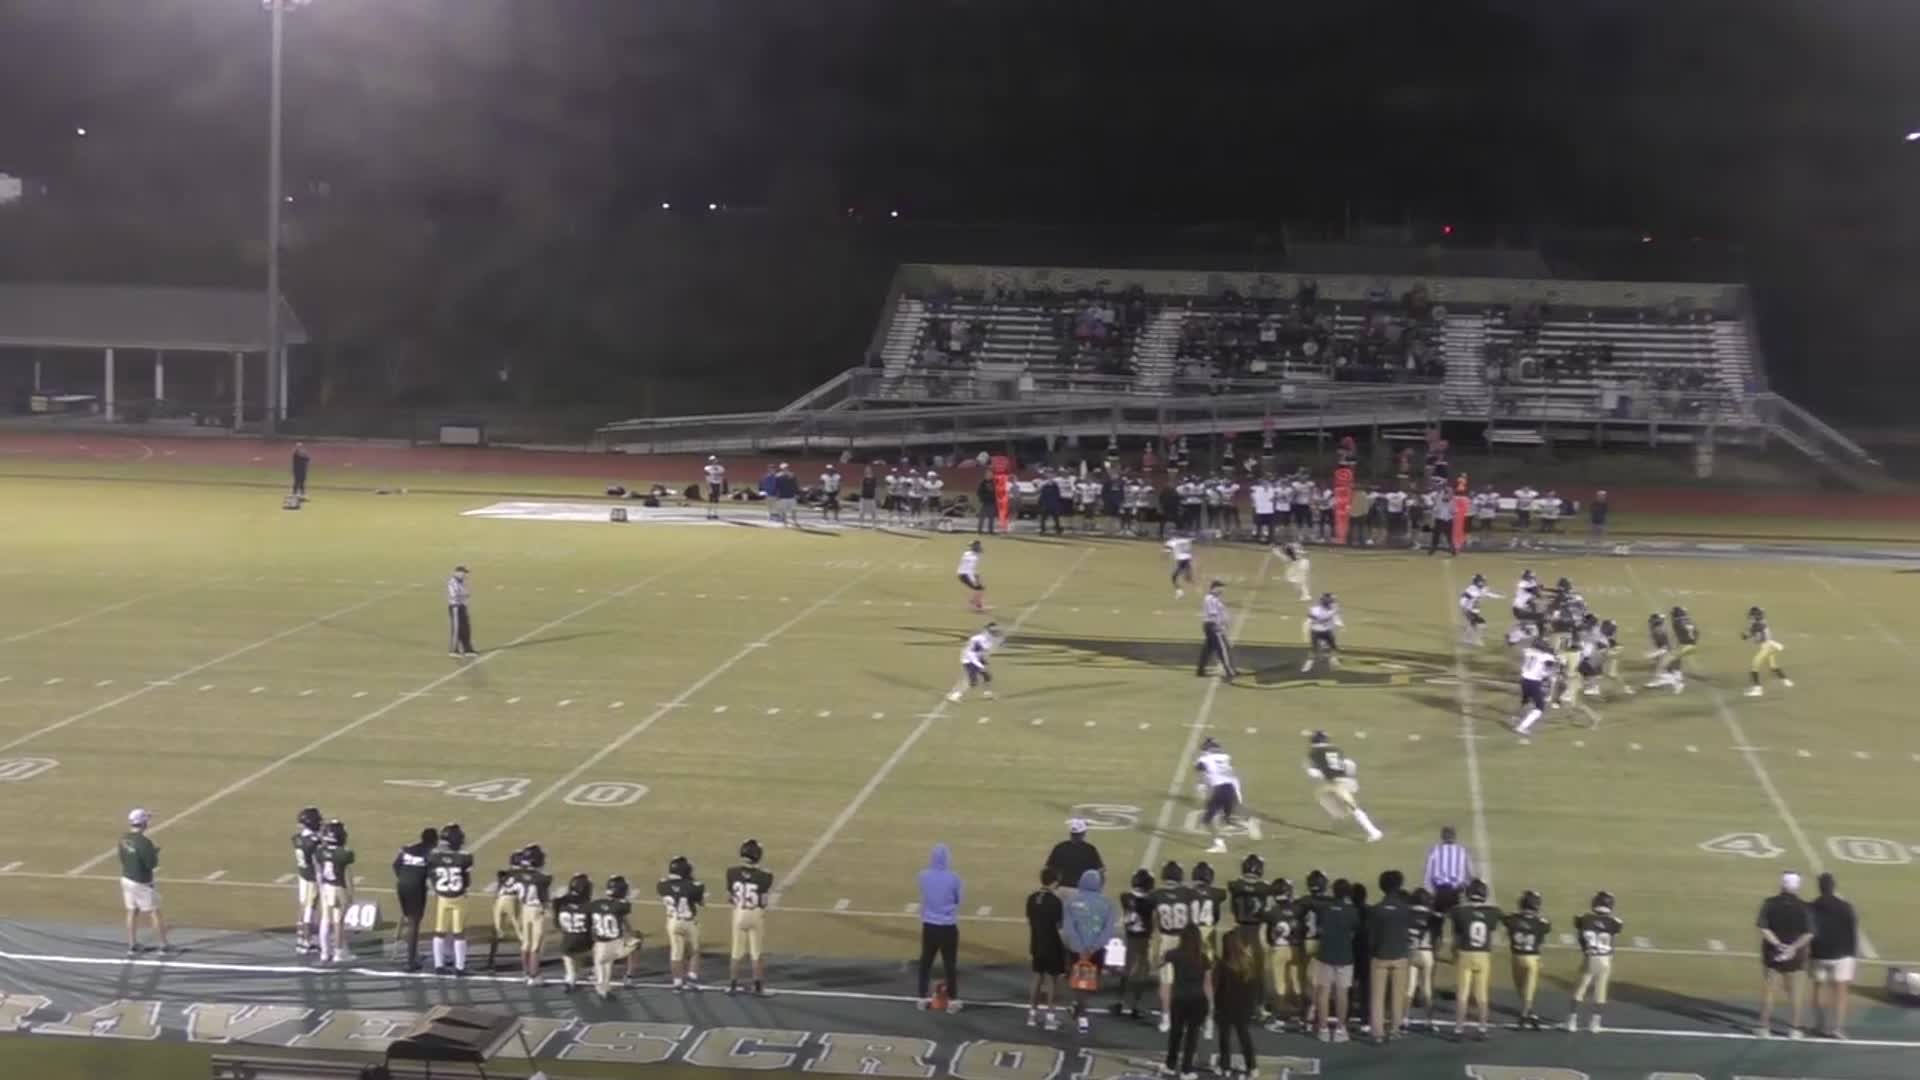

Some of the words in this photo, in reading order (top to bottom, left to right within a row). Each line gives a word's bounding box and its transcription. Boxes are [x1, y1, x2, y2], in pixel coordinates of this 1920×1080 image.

[433, 866, 464, 893] 25
[342, 903, 377, 927] 40
[1469, 921, 1487, 948] 9
